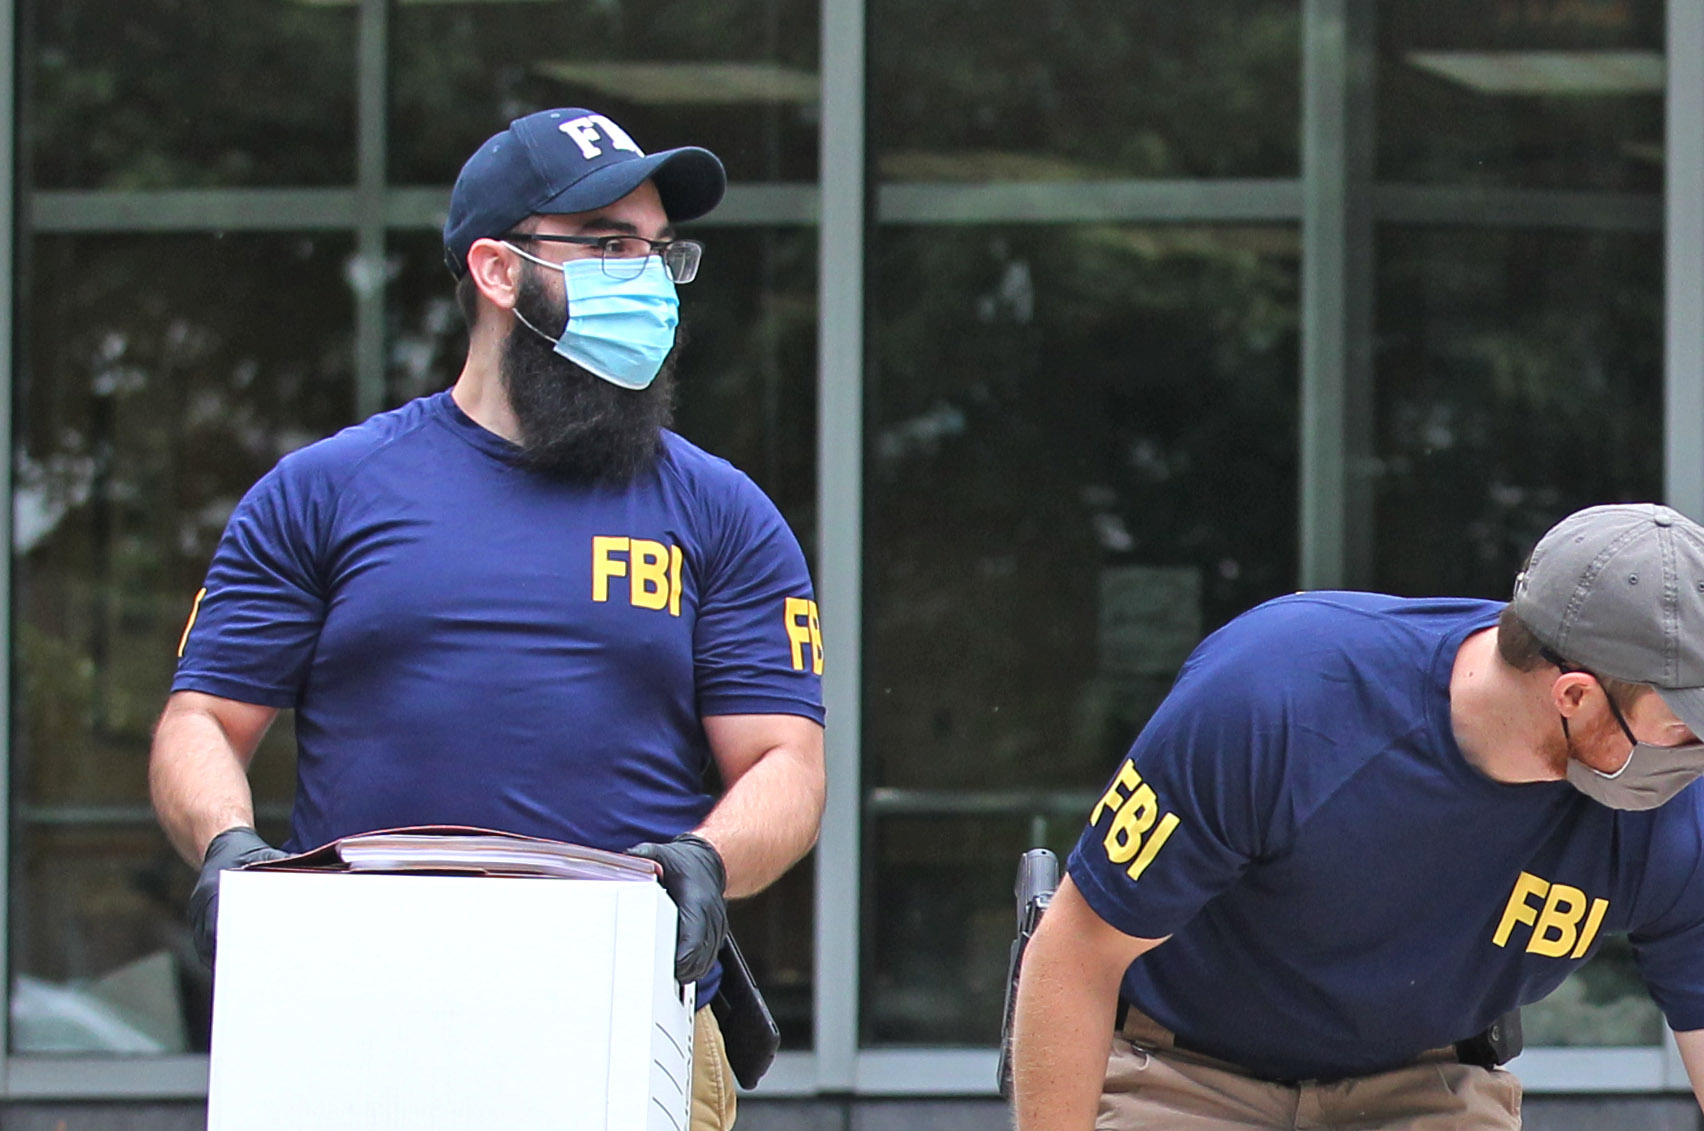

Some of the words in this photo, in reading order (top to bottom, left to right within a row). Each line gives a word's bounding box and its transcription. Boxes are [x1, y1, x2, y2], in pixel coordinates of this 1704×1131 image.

[592, 535, 683, 617] FBI
[1090, 759, 1180, 881] FBI
[1492, 871, 1609, 959] FBI
